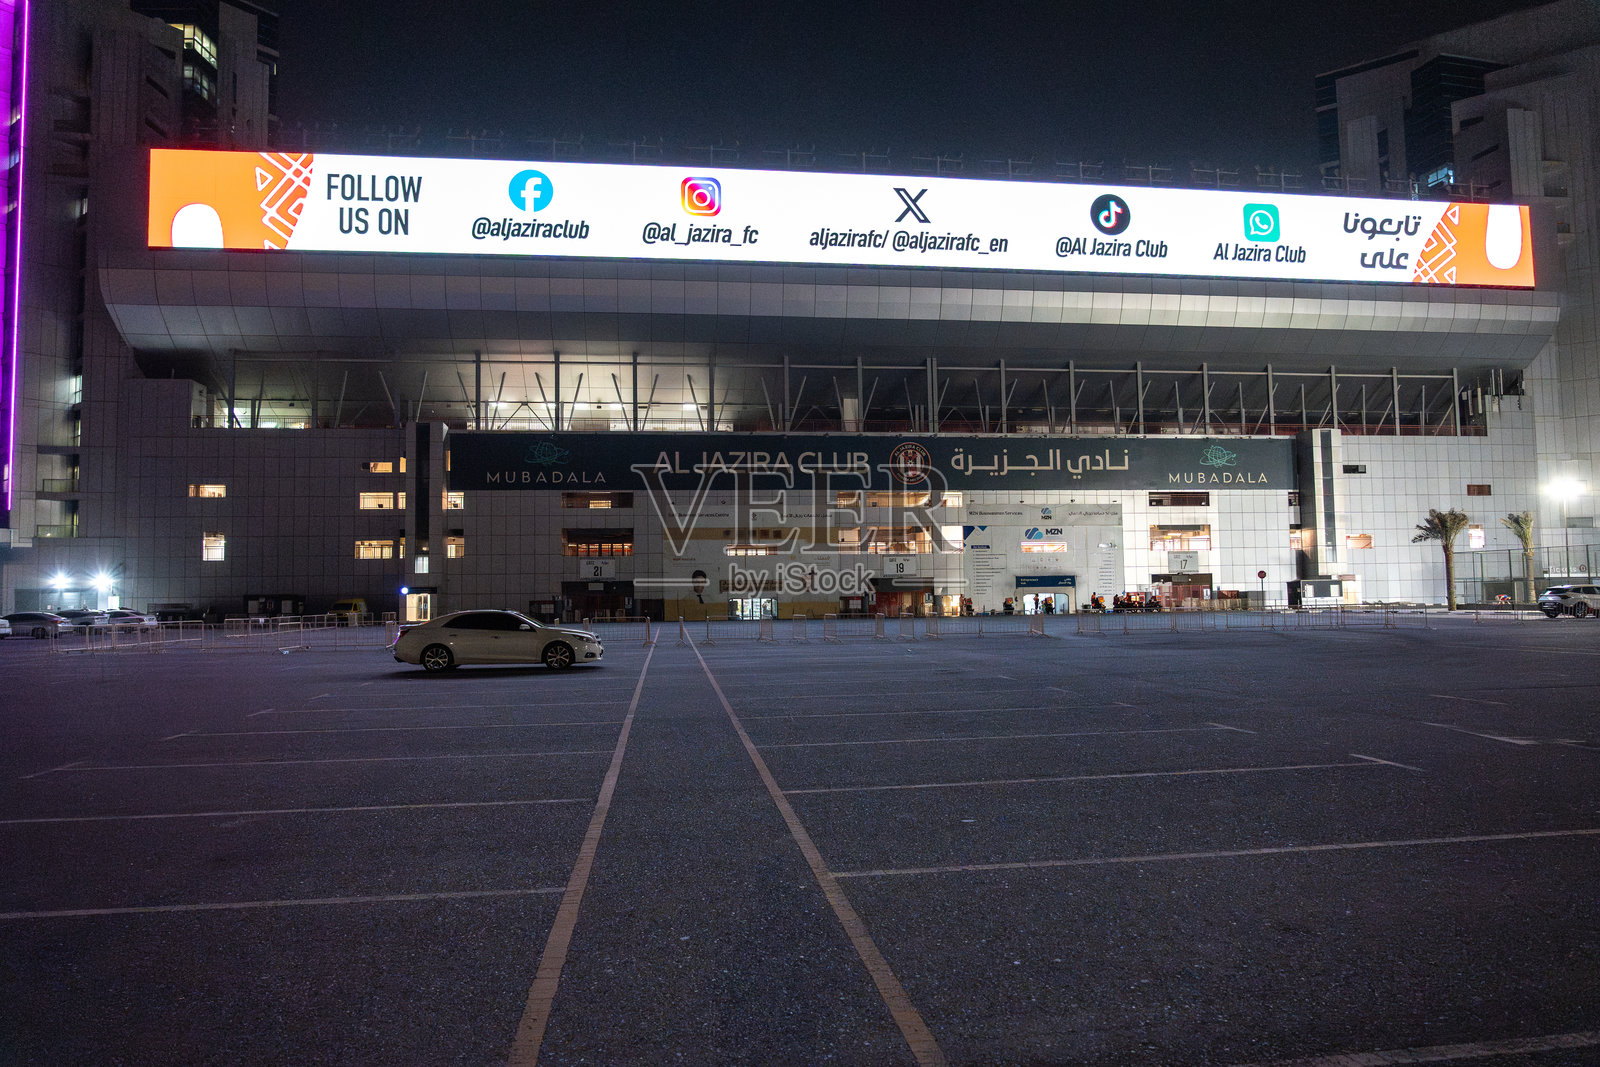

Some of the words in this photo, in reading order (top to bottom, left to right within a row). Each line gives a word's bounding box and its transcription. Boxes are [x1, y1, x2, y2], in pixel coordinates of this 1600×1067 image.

[327, 173, 422, 202] FOLLOW
[339, 207, 369, 234] US
[378, 208, 409, 235] ON
[471, 216, 590, 241] @aljaziraclub
[1343, 212, 1422, 240] تابعونا
[641, 221, 759, 246] @al_jazira_fc
[809, 228, 889, 250] aljazirafc/
[892, 230, 1008, 255] @aljazirafc_en
[1055, 236, 1087, 258] @Al
[1090, 238, 1132, 257] Jazira
[1135, 239, 1168, 258] Club
[1213, 242, 1231, 261] Al
[1232, 244, 1272, 263] Jazira
[1274, 244, 1307, 263] Club
[1360, 248, 1409, 270] على
[652, 451, 690, 474] AL
[695, 451, 792, 474] JAZIRA
[797, 451, 869, 474] CLUB
[951, 448, 1061, 476] الجزيرة
[1066, 449, 1129, 479] نادي
[486, 471, 607, 484] MUBADALA
[1168, 472, 1268, 484] MUBADALA
[593, 565, 603, 577] 21
[895, 562, 905, 574] 19
[1180, 559, 1188, 570] 17
